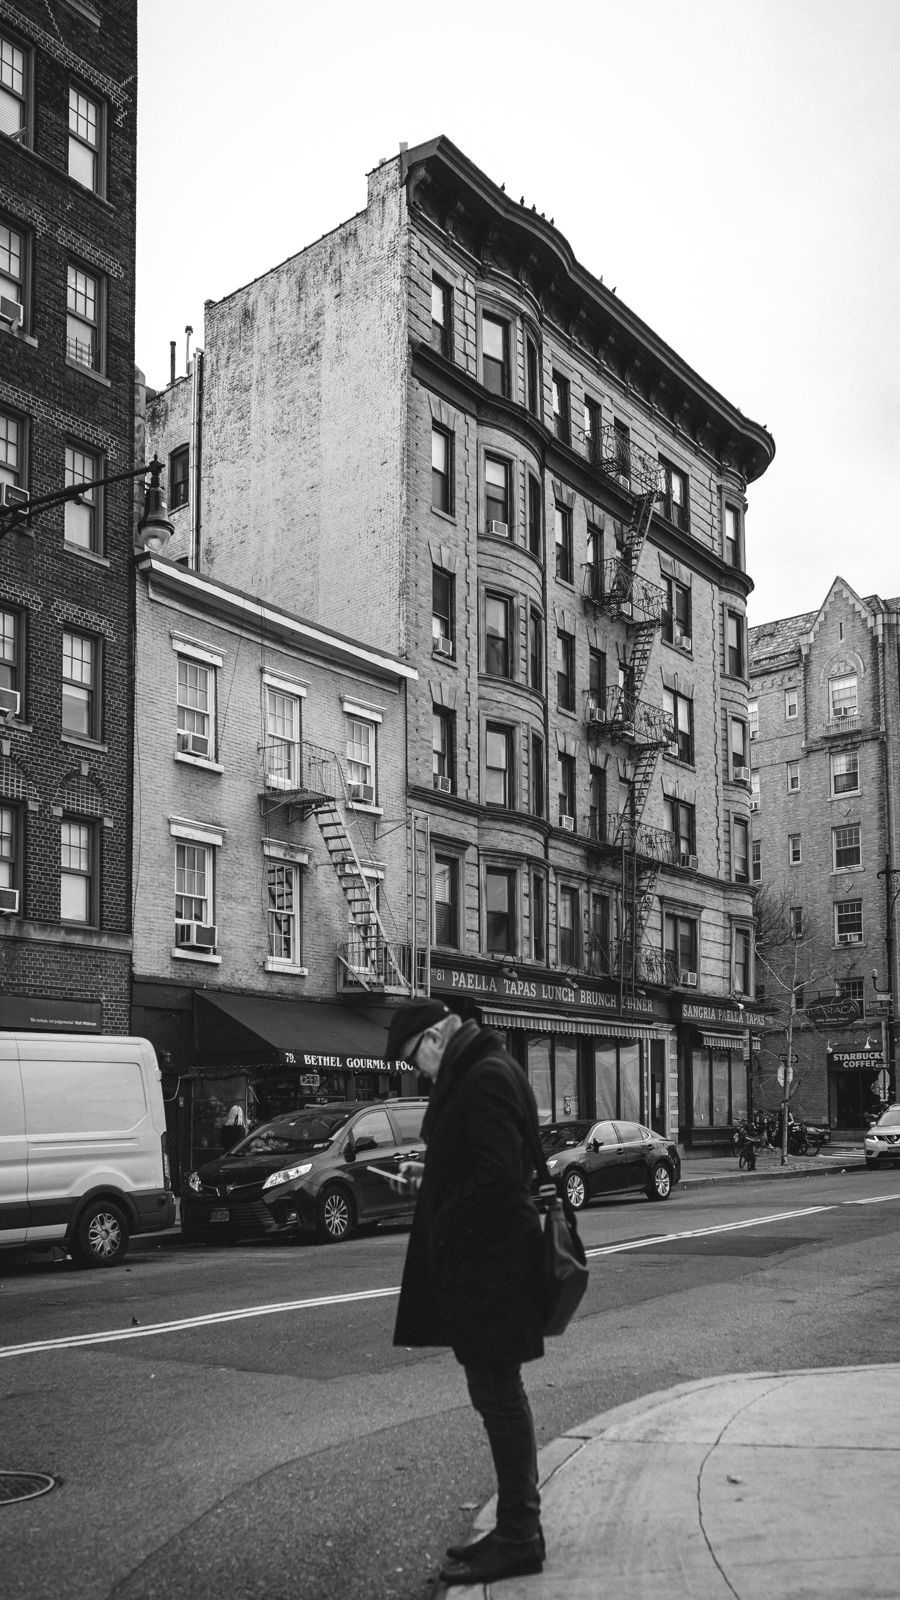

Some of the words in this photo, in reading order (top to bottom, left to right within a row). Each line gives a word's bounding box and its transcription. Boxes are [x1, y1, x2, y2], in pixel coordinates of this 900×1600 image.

[451, 970, 498, 993] PAELLA
[503, 978, 537, 998] TAPAS
[541, 983, 576, 1003] LUNCH
[580, 989, 617, 1008] BRUNCH
[682, 1003, 716, 1020] SANGRIA
[717, 1008, 744, 1024] PAELLA
[745, 1012, 765, 1026] TAPAS
[285, 1051, 296, 1064] 79.
[303, 1054, 343, 1068] BETHEL
[395, 1060, 414, 1071] FOO
[833, 1052, 885, 1061] STARBUCKS
